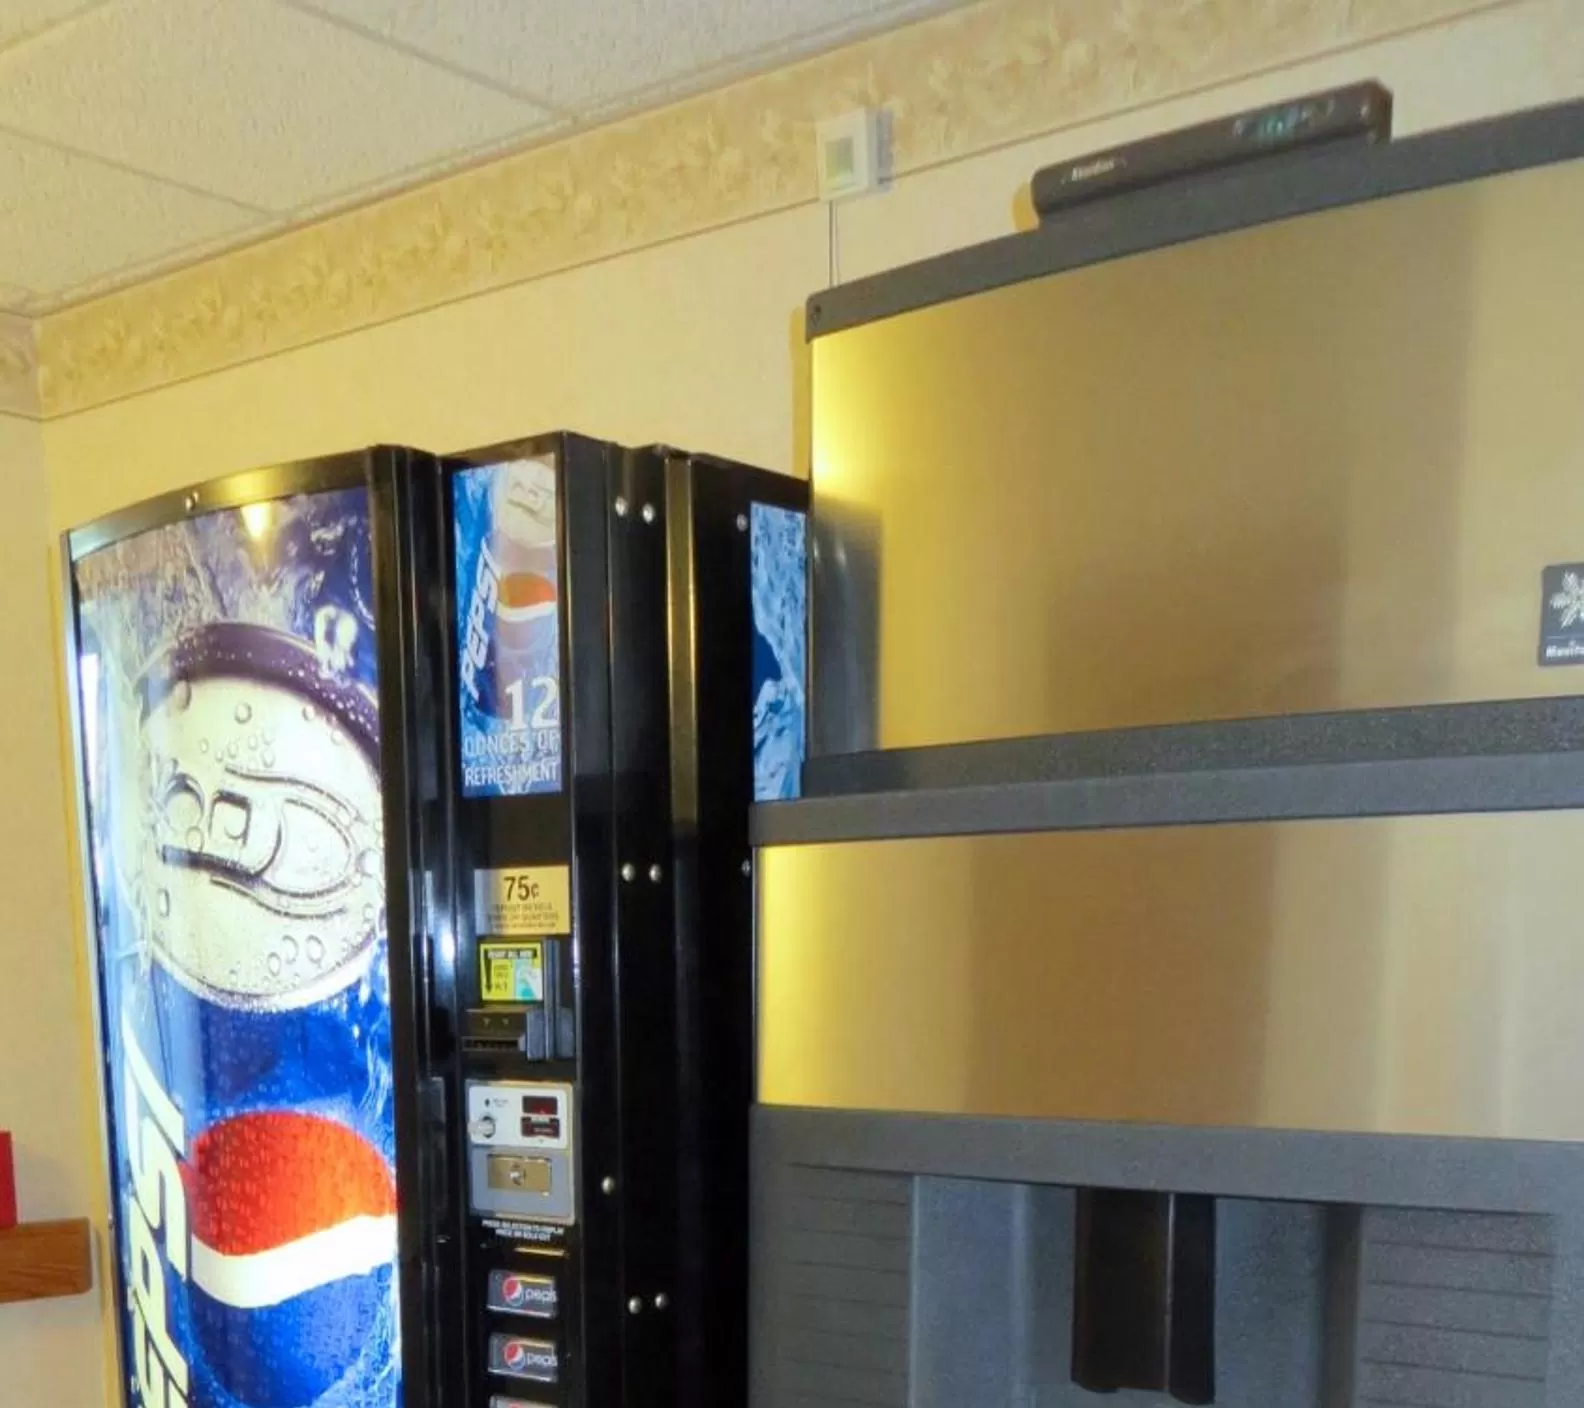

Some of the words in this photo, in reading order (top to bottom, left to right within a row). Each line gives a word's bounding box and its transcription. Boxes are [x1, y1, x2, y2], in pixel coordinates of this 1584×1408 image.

[460, 535, 501, 701] PEPSI
[505, 676, 560, 731] 12
[464, 731, 531, 758] OUNCES
[463, 761, 558, 787] REFRESHMENT
[524, 1287, 557, 1304] peps
[527, 1352, 558, 1368] peps
